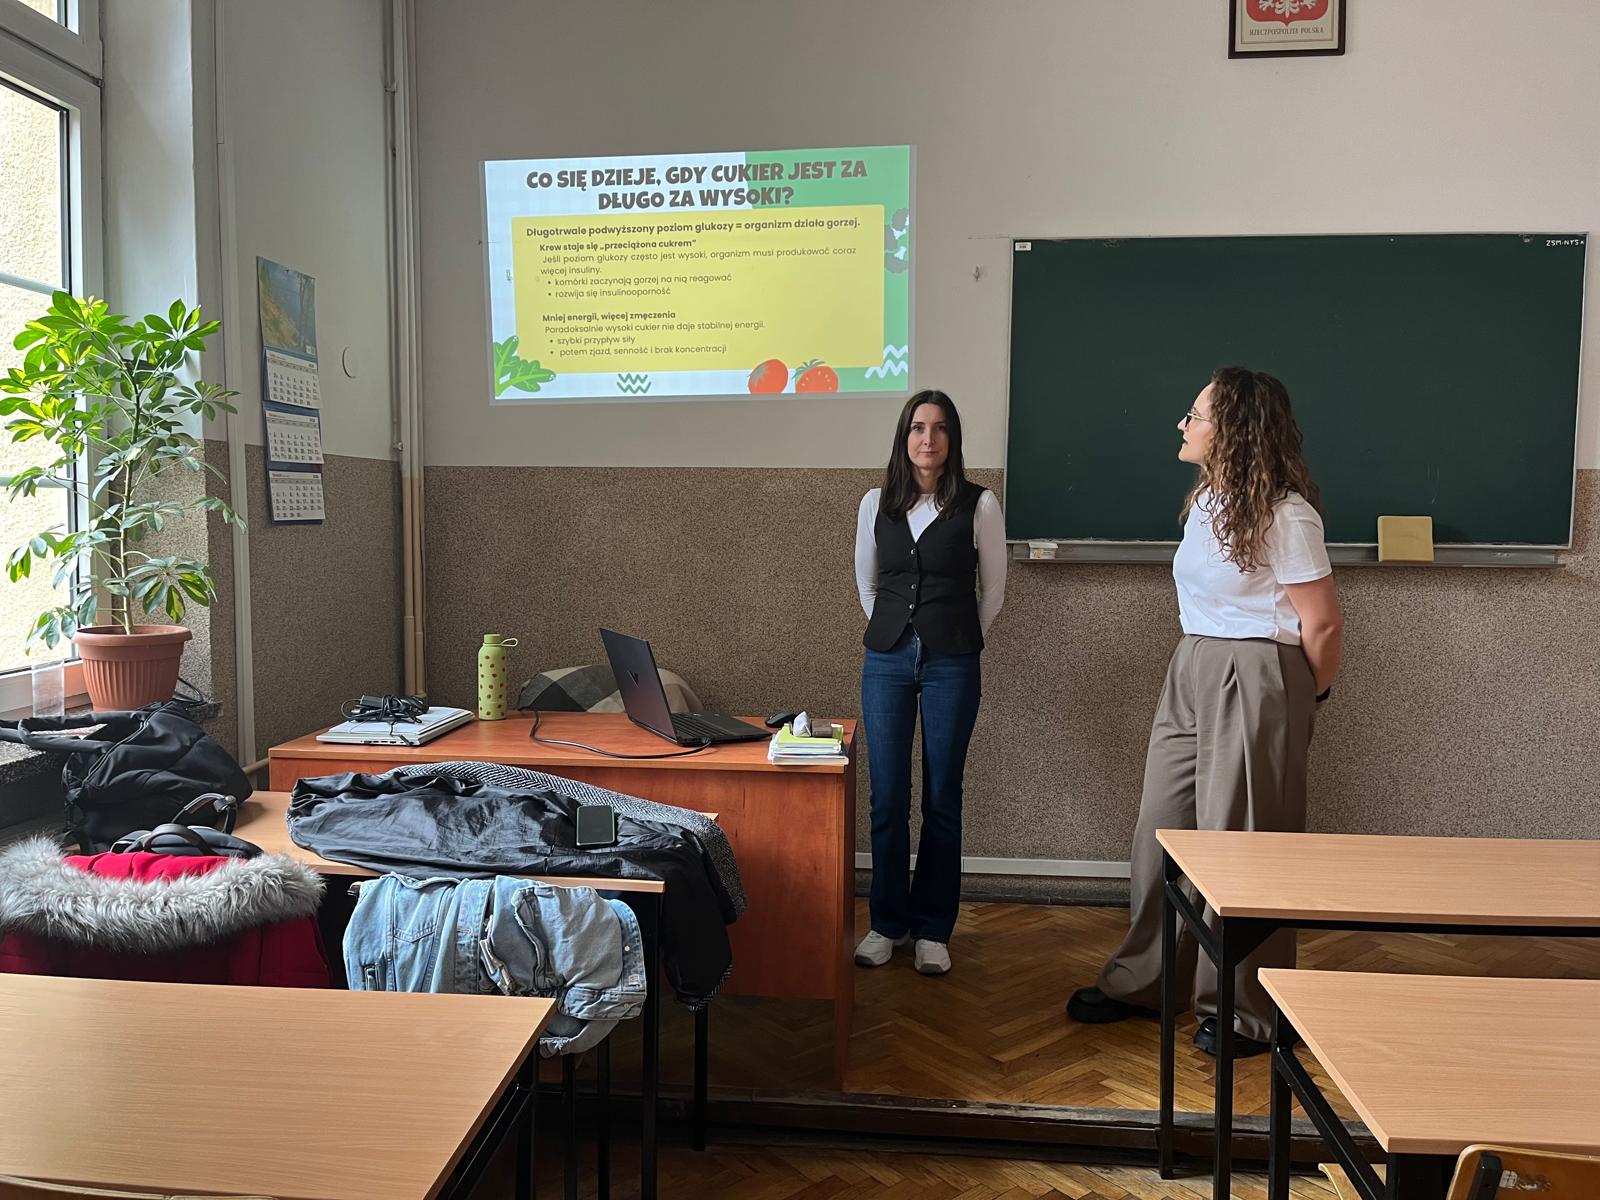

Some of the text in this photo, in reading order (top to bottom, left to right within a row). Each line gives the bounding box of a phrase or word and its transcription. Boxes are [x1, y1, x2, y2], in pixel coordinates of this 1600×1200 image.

[1250, 26, 1324, 36] RZECZPOSPOLITA POLSKA
[527, 160, 868, 191] CO SIĘ DZIEJE, GDY CUKIER JEST ZA
[598, 186, 794, 210] DŁUGO ZA WYSOKI?
[588, 226, 654, 237] podwyższony
[656, 223, 692, 234] poziom
[695, 222, 734, 233] glukozy
[744, 220, 792, 231] organizm
[794, 218, 824, 228] działa
[826, 218, 860, 229] gorzej.
[563, 244, 584, 252] staje
[586, 242, 598, 252] się
[542, 255, 561, 263] Jeśli
[563, 254, 594, 264] poziom
[597, 253, 628, 264] glukozy
[630, 253, 658, 262] często
[660, 252, 675, 261] jest
[678, 250, 708, 260] wysoki,
[710, 249, 750, 260] organizm
[752, 249, 774, 257] musi
[776, 248, 829, 258] produkować
[540, 266, 602, 276] więcej insuliny.
[555, 277, 588, 286] komórki
[590, 276, 632, 286] zaczynają
[633, 275, 659, 285] gorzej
[674, 275, 688, 284] nią
[689, 273, 732, 283] reagować
[555, 288, 671, 298] rozwija się insulinooporność
[542, 311, 676, 323] Mniej energii, więcej zmęczenia
[545, 325, 603, 334] Paradoksalnie
[605, 324, 632, 333] wysoki
[662, 322, 674, 330] nie
[676, 322, 695, 332] daje
[697, 321, 732, 331] stabilnej
[557, 336, 635, 346] szybki przypływ siły
[560, 348, 587, 357] potem
[589, 348, 612, 356] zjazd,
[675, 344, 727, 354] koncentracji
